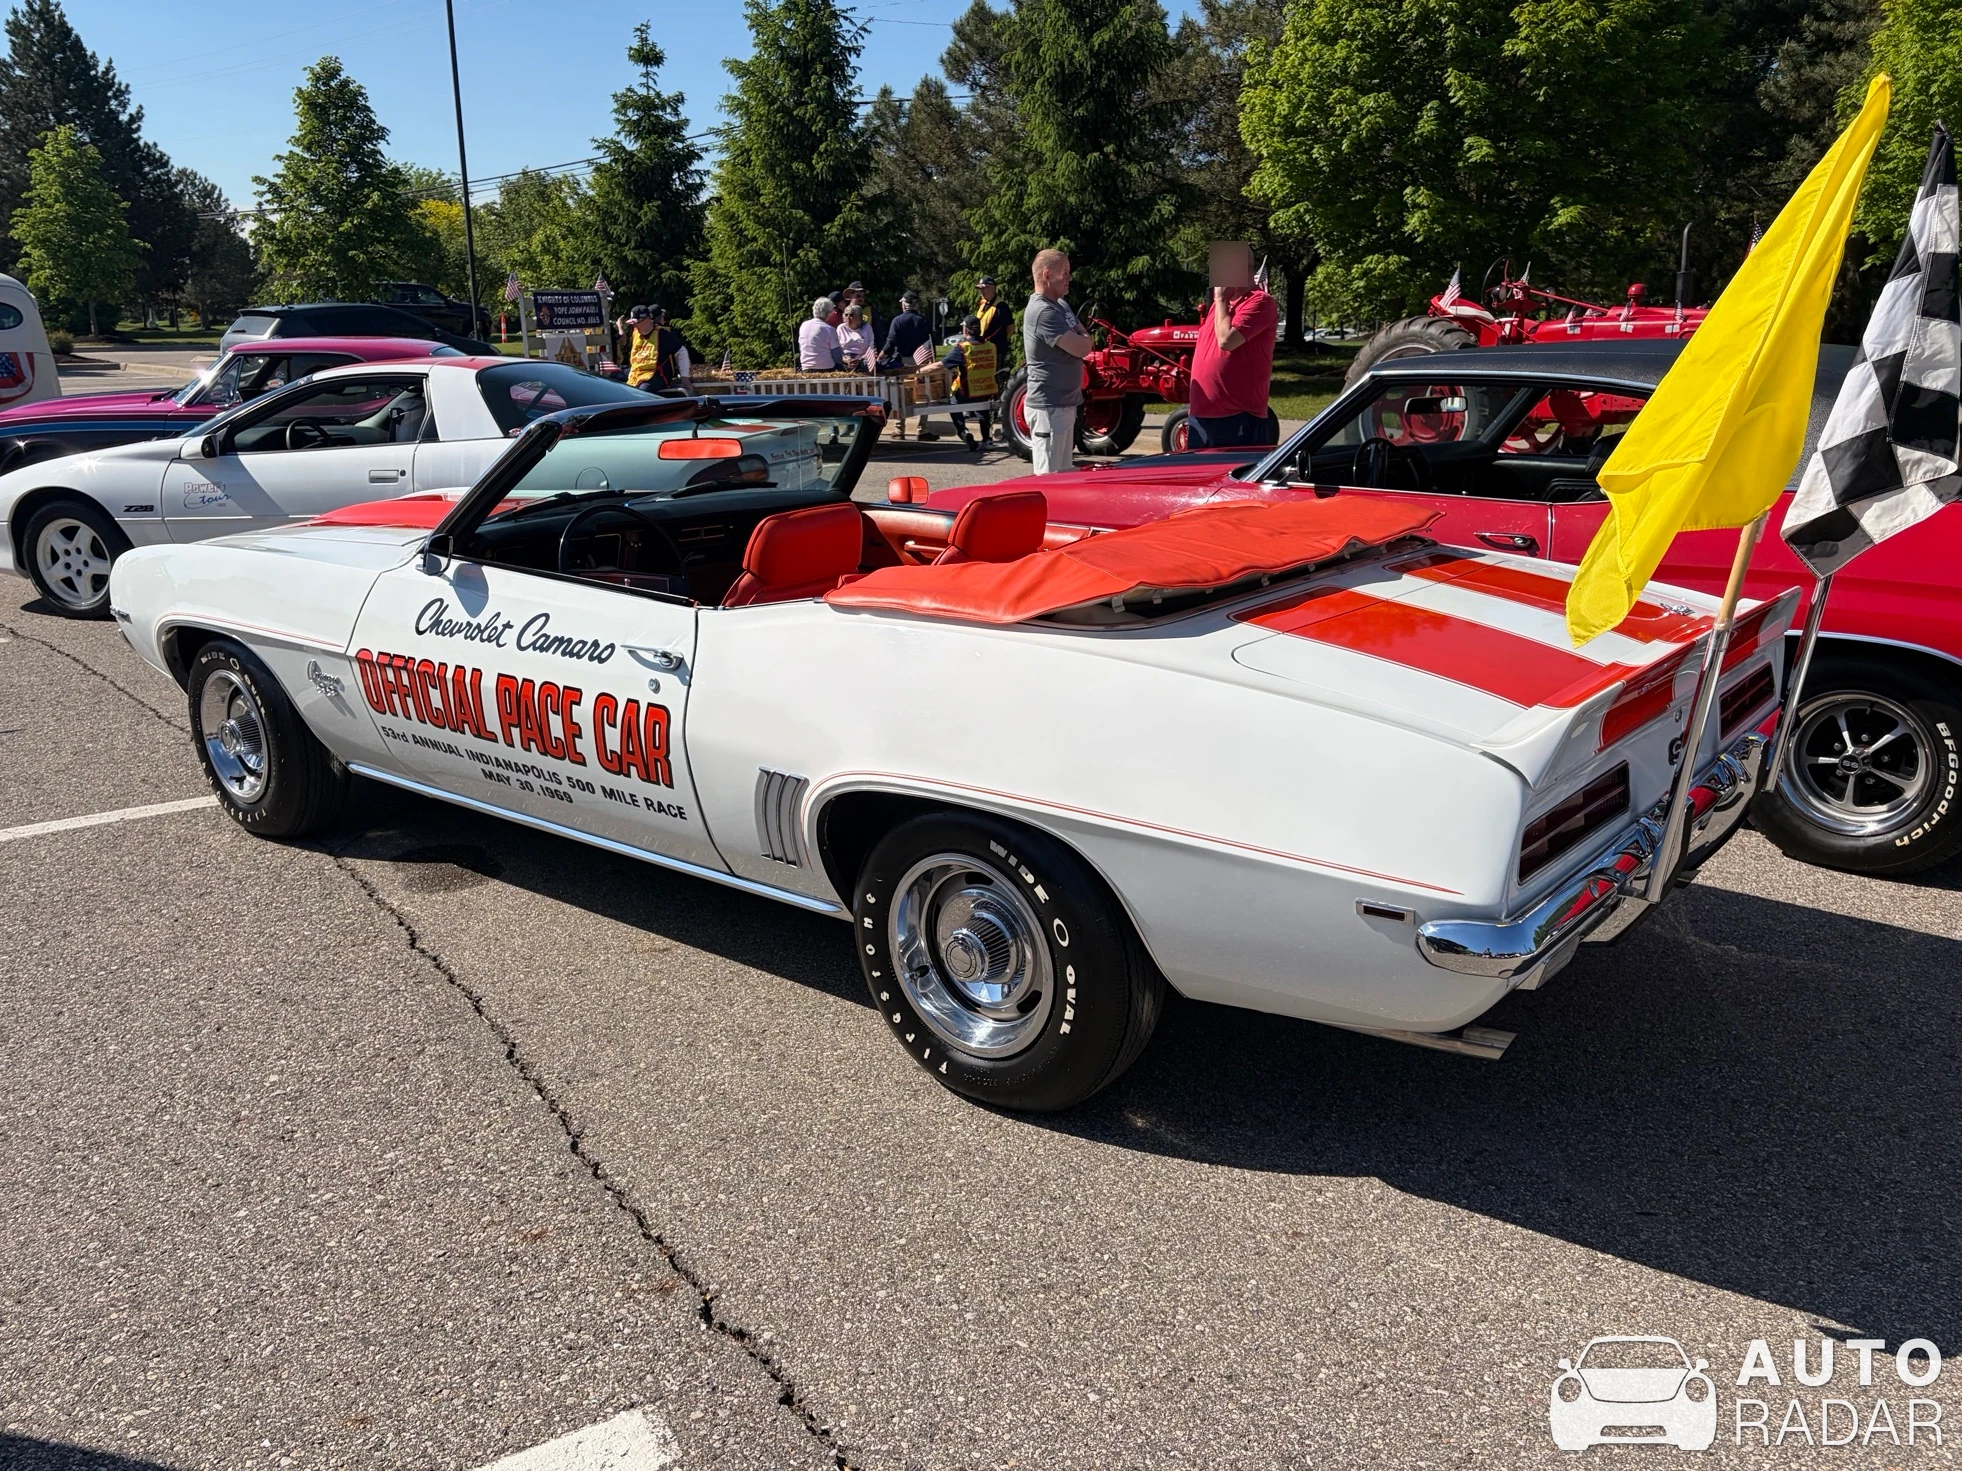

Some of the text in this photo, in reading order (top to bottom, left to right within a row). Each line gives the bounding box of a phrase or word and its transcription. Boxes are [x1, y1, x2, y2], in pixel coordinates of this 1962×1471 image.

[536, 295, 598, 304] KNIGHTS OF COLUMBUS
[554, 306, 568, 315] POPE
[568, 306, 583, 314] JOHN
[553, 317, 576, 325] COUNCIL
[183, 481, 220, 494] Power
[199, 494, 232, 505] tour
[123, 504, 155, 513] Z28
[414, 597, 616, 665] Chevrolet Camaro
[355, 647, 675, 789] OFFICIAL PACE CAR
[380, 725, 688, 821] 53rd ANNUAL INDIANAPOLIS 500 MILE RACE
[480, 767, 512, 787] MAY
[1894, 722, 1960, 848] BFGoodrich
[989, 839, 1050, 904] WIDE
[1059, 964, 1077, 1036] OVAL
